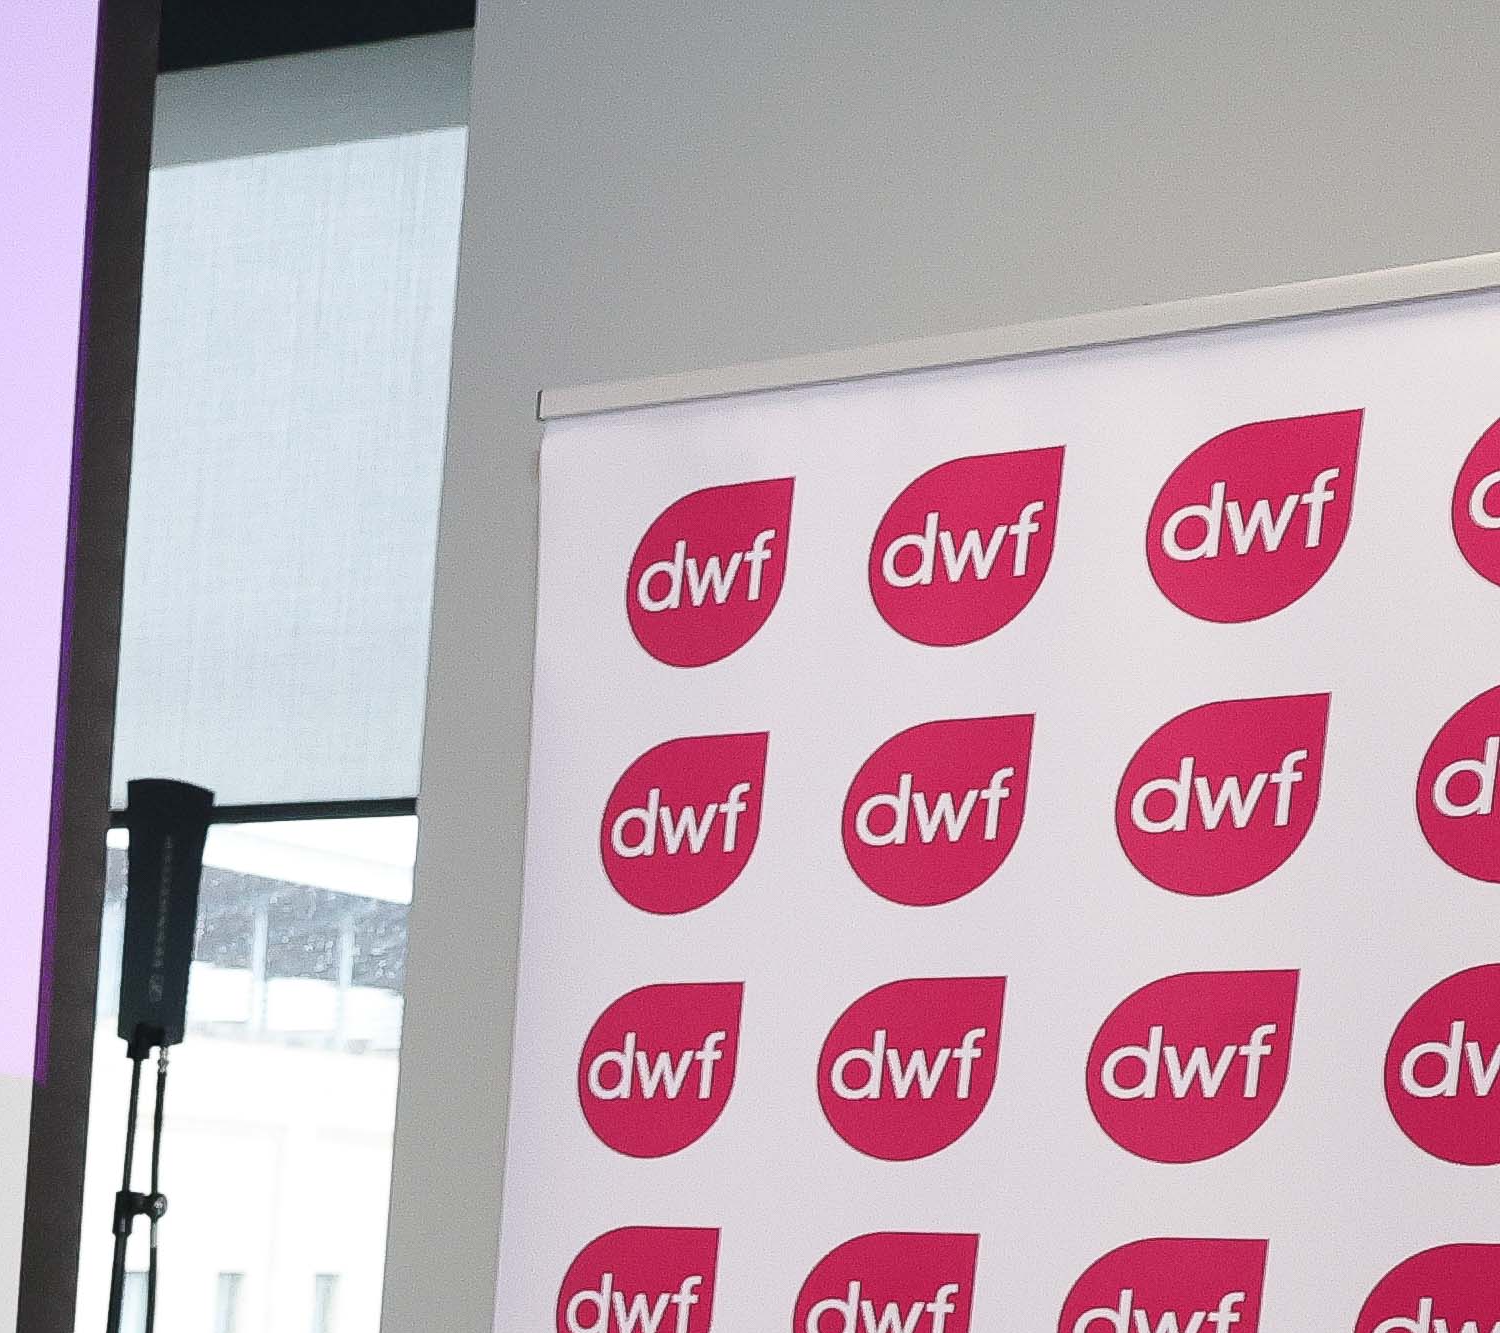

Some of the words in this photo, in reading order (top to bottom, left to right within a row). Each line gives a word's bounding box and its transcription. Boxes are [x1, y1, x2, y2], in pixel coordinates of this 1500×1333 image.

[881, 500, 1045, 588] dwf
[1160, 467, 1340, 562] dwf
[636, 528, 776, 613] dwf
[610, 782, 751, 858] dwf
[855, 766, 1015, 847] dwf
[1130, 749, 1308, 834] dwf
[587, 1030, 727, 1100] dwf
[830, 1027, 987, 1100] dwf
[1100, 1023, 1277, 1100] dwf
